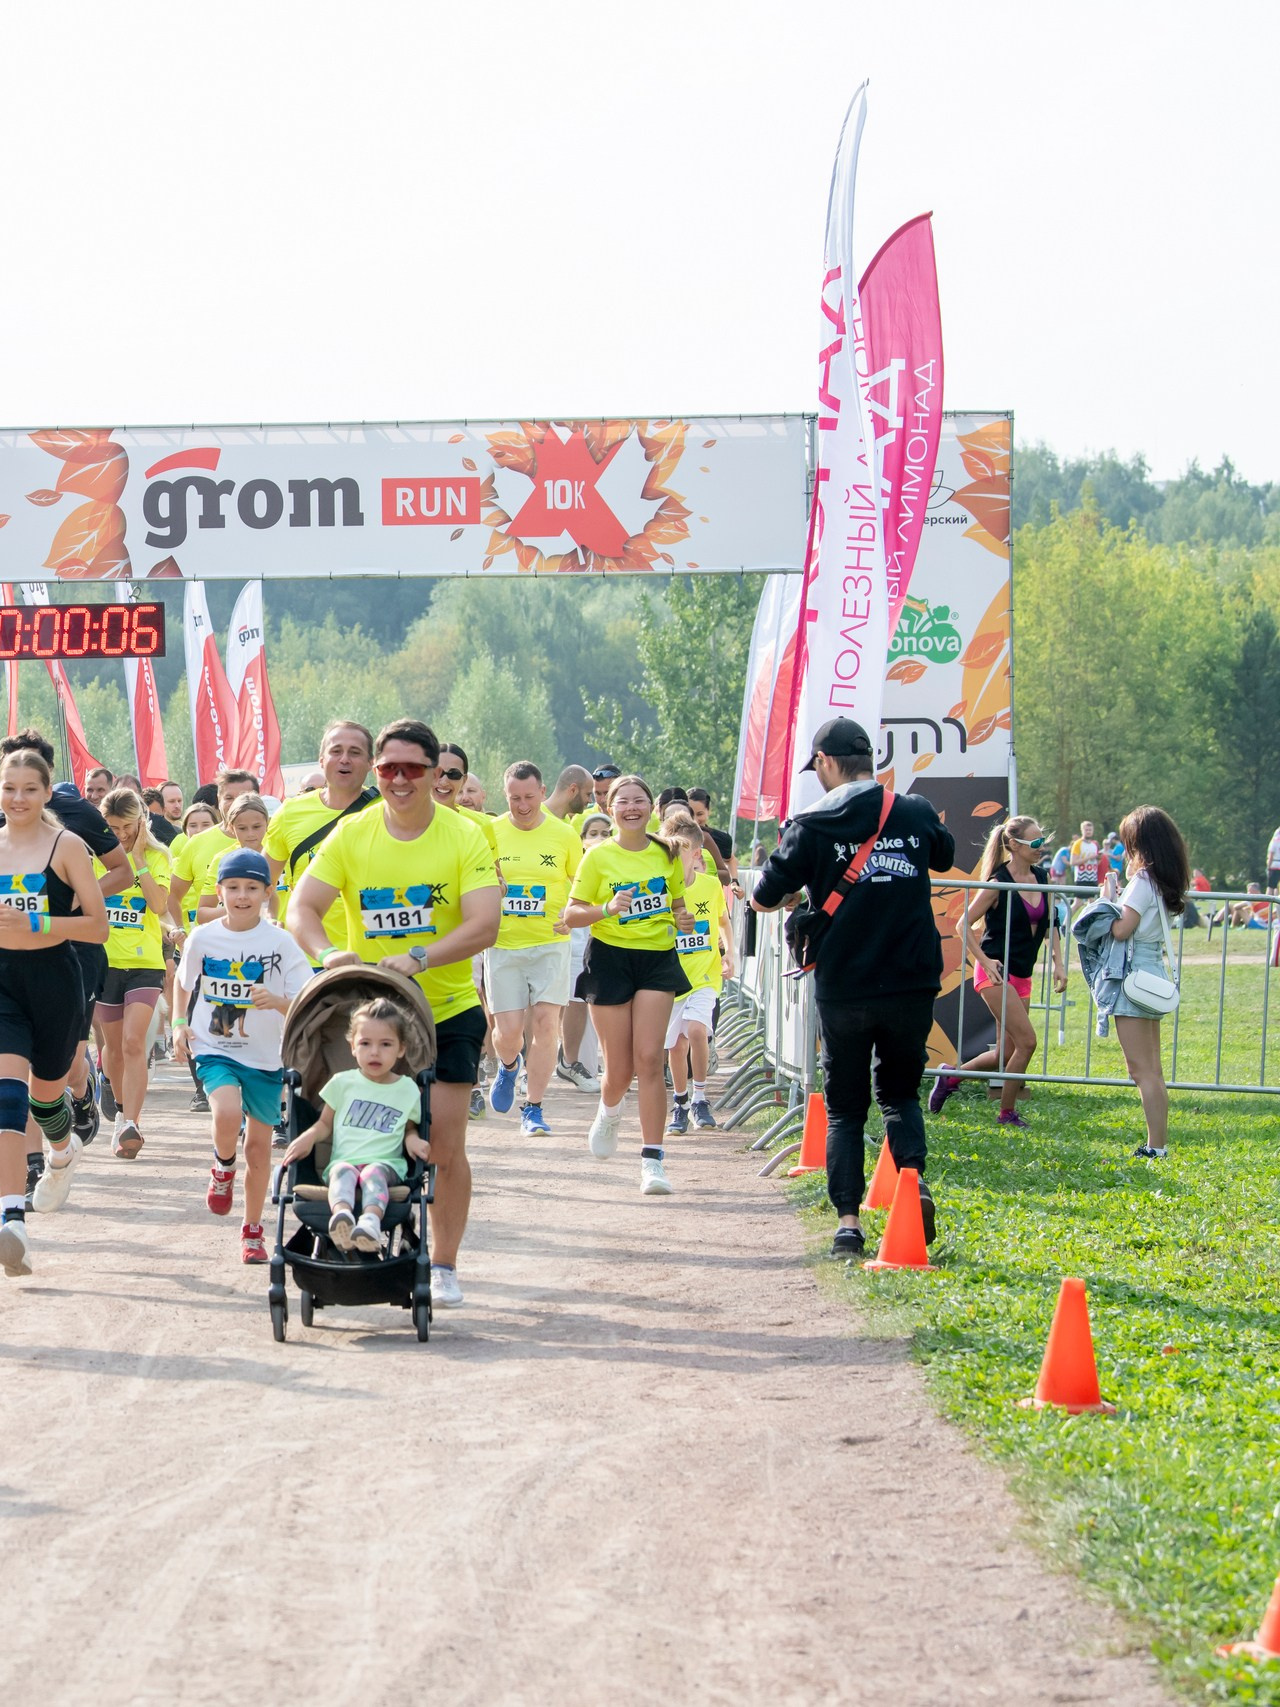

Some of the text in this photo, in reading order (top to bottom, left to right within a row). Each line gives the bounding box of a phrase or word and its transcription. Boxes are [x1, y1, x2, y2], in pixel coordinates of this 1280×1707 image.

[897, 359, 936, 542] ЛИМОНАД
[544, 479, 586, 510] 10K
[142, 475, 467, 548] grom RUN
[828, 484, 877, 708] ПОЛЕЗНЫЙ
[871, 854, 916, 877] CONTEST
[106, 909, 138, 923] 1169
[373, 909, 423, 929] 1181
[508, 900, 539, 911] 1187
[210, 981, 253, 998] 1197
[342, 1099, 403, 1134] NIKE
